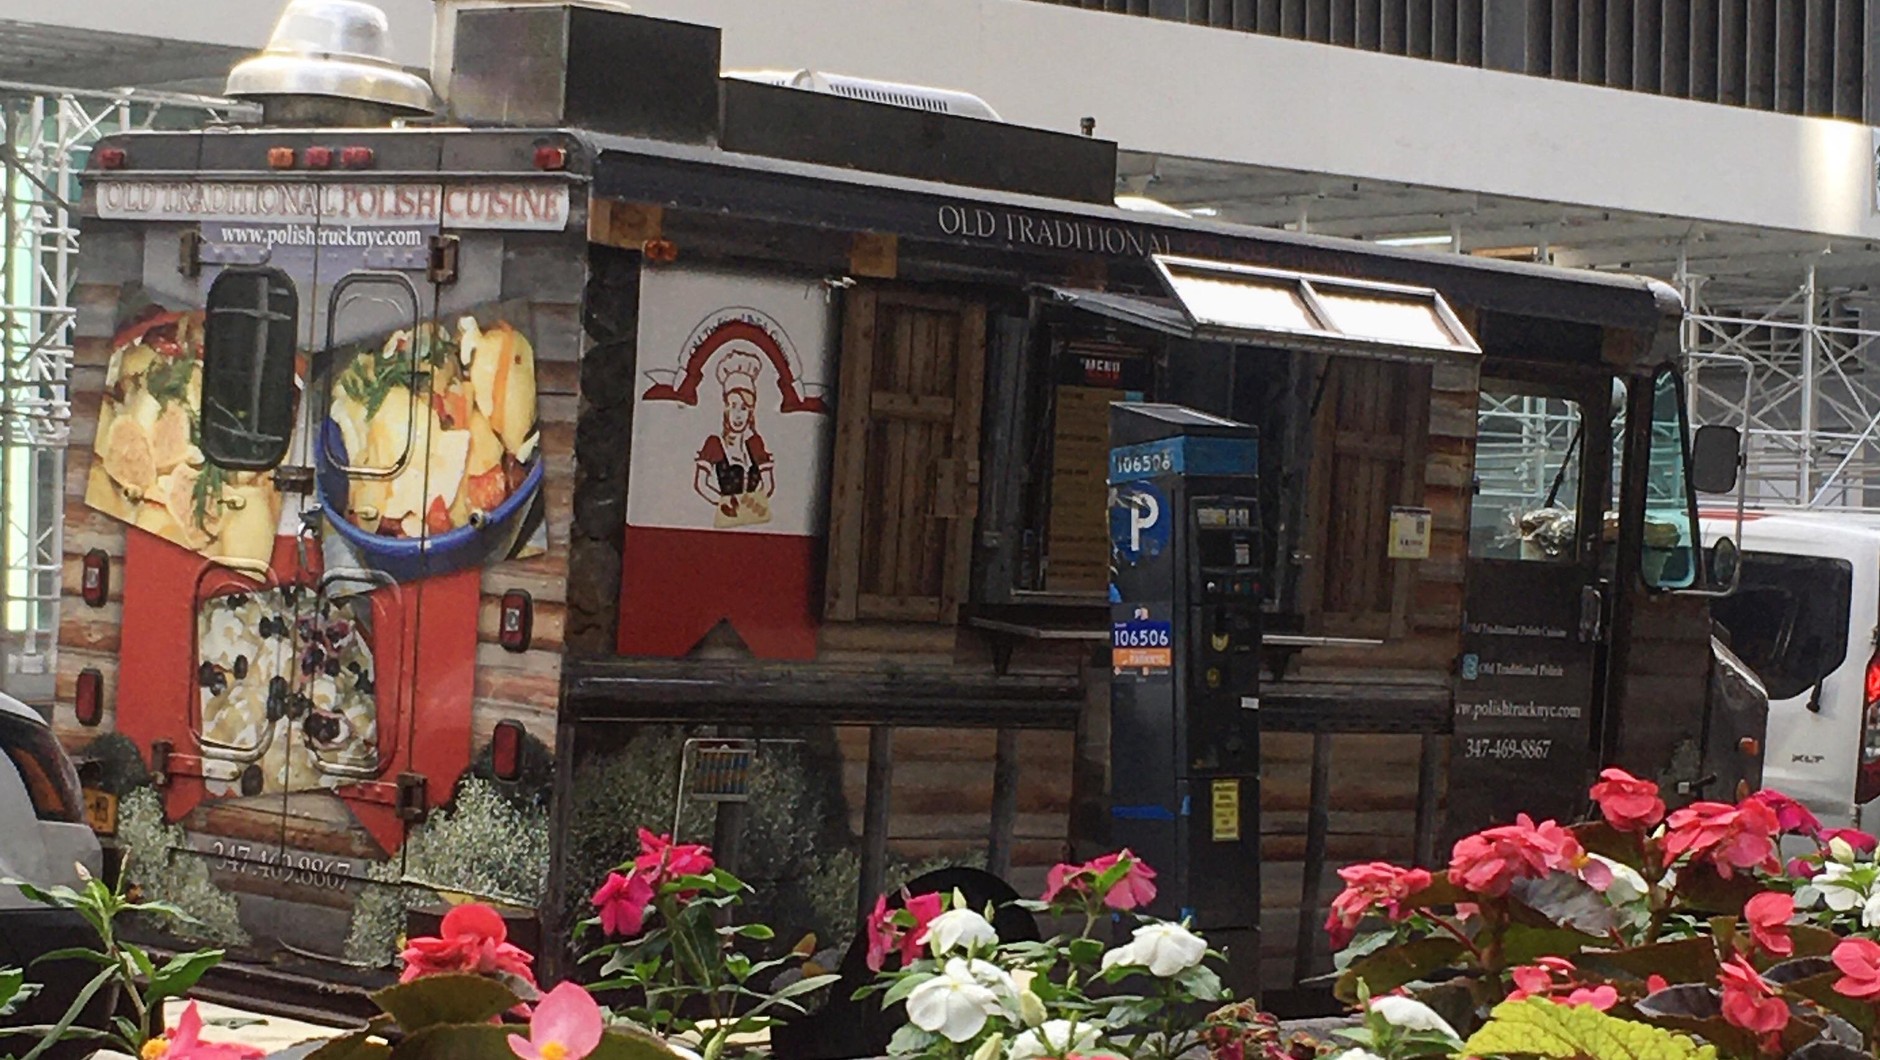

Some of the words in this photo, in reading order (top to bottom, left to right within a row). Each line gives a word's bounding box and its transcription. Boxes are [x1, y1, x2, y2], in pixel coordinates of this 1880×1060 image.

[102, 182, 157, 213] OLD
[159, 183, 337, 217] TRADITIONAL
[341, 184, 438, 219] POLISH
[443, 186, 563, 222] CUISINE
[938, 205, 996, 238] OLD
[220, 224, 422, 250] www.polishtrucknyc.com
[1117, 453, 1171, 474] 106506
[1130, 493, 1159, 551] P
[1114, 629, 1169, 647] 106506
[1465, 738, 1552, 759] 347-469-8867
[1791, 753, 1825, 763] XLT
